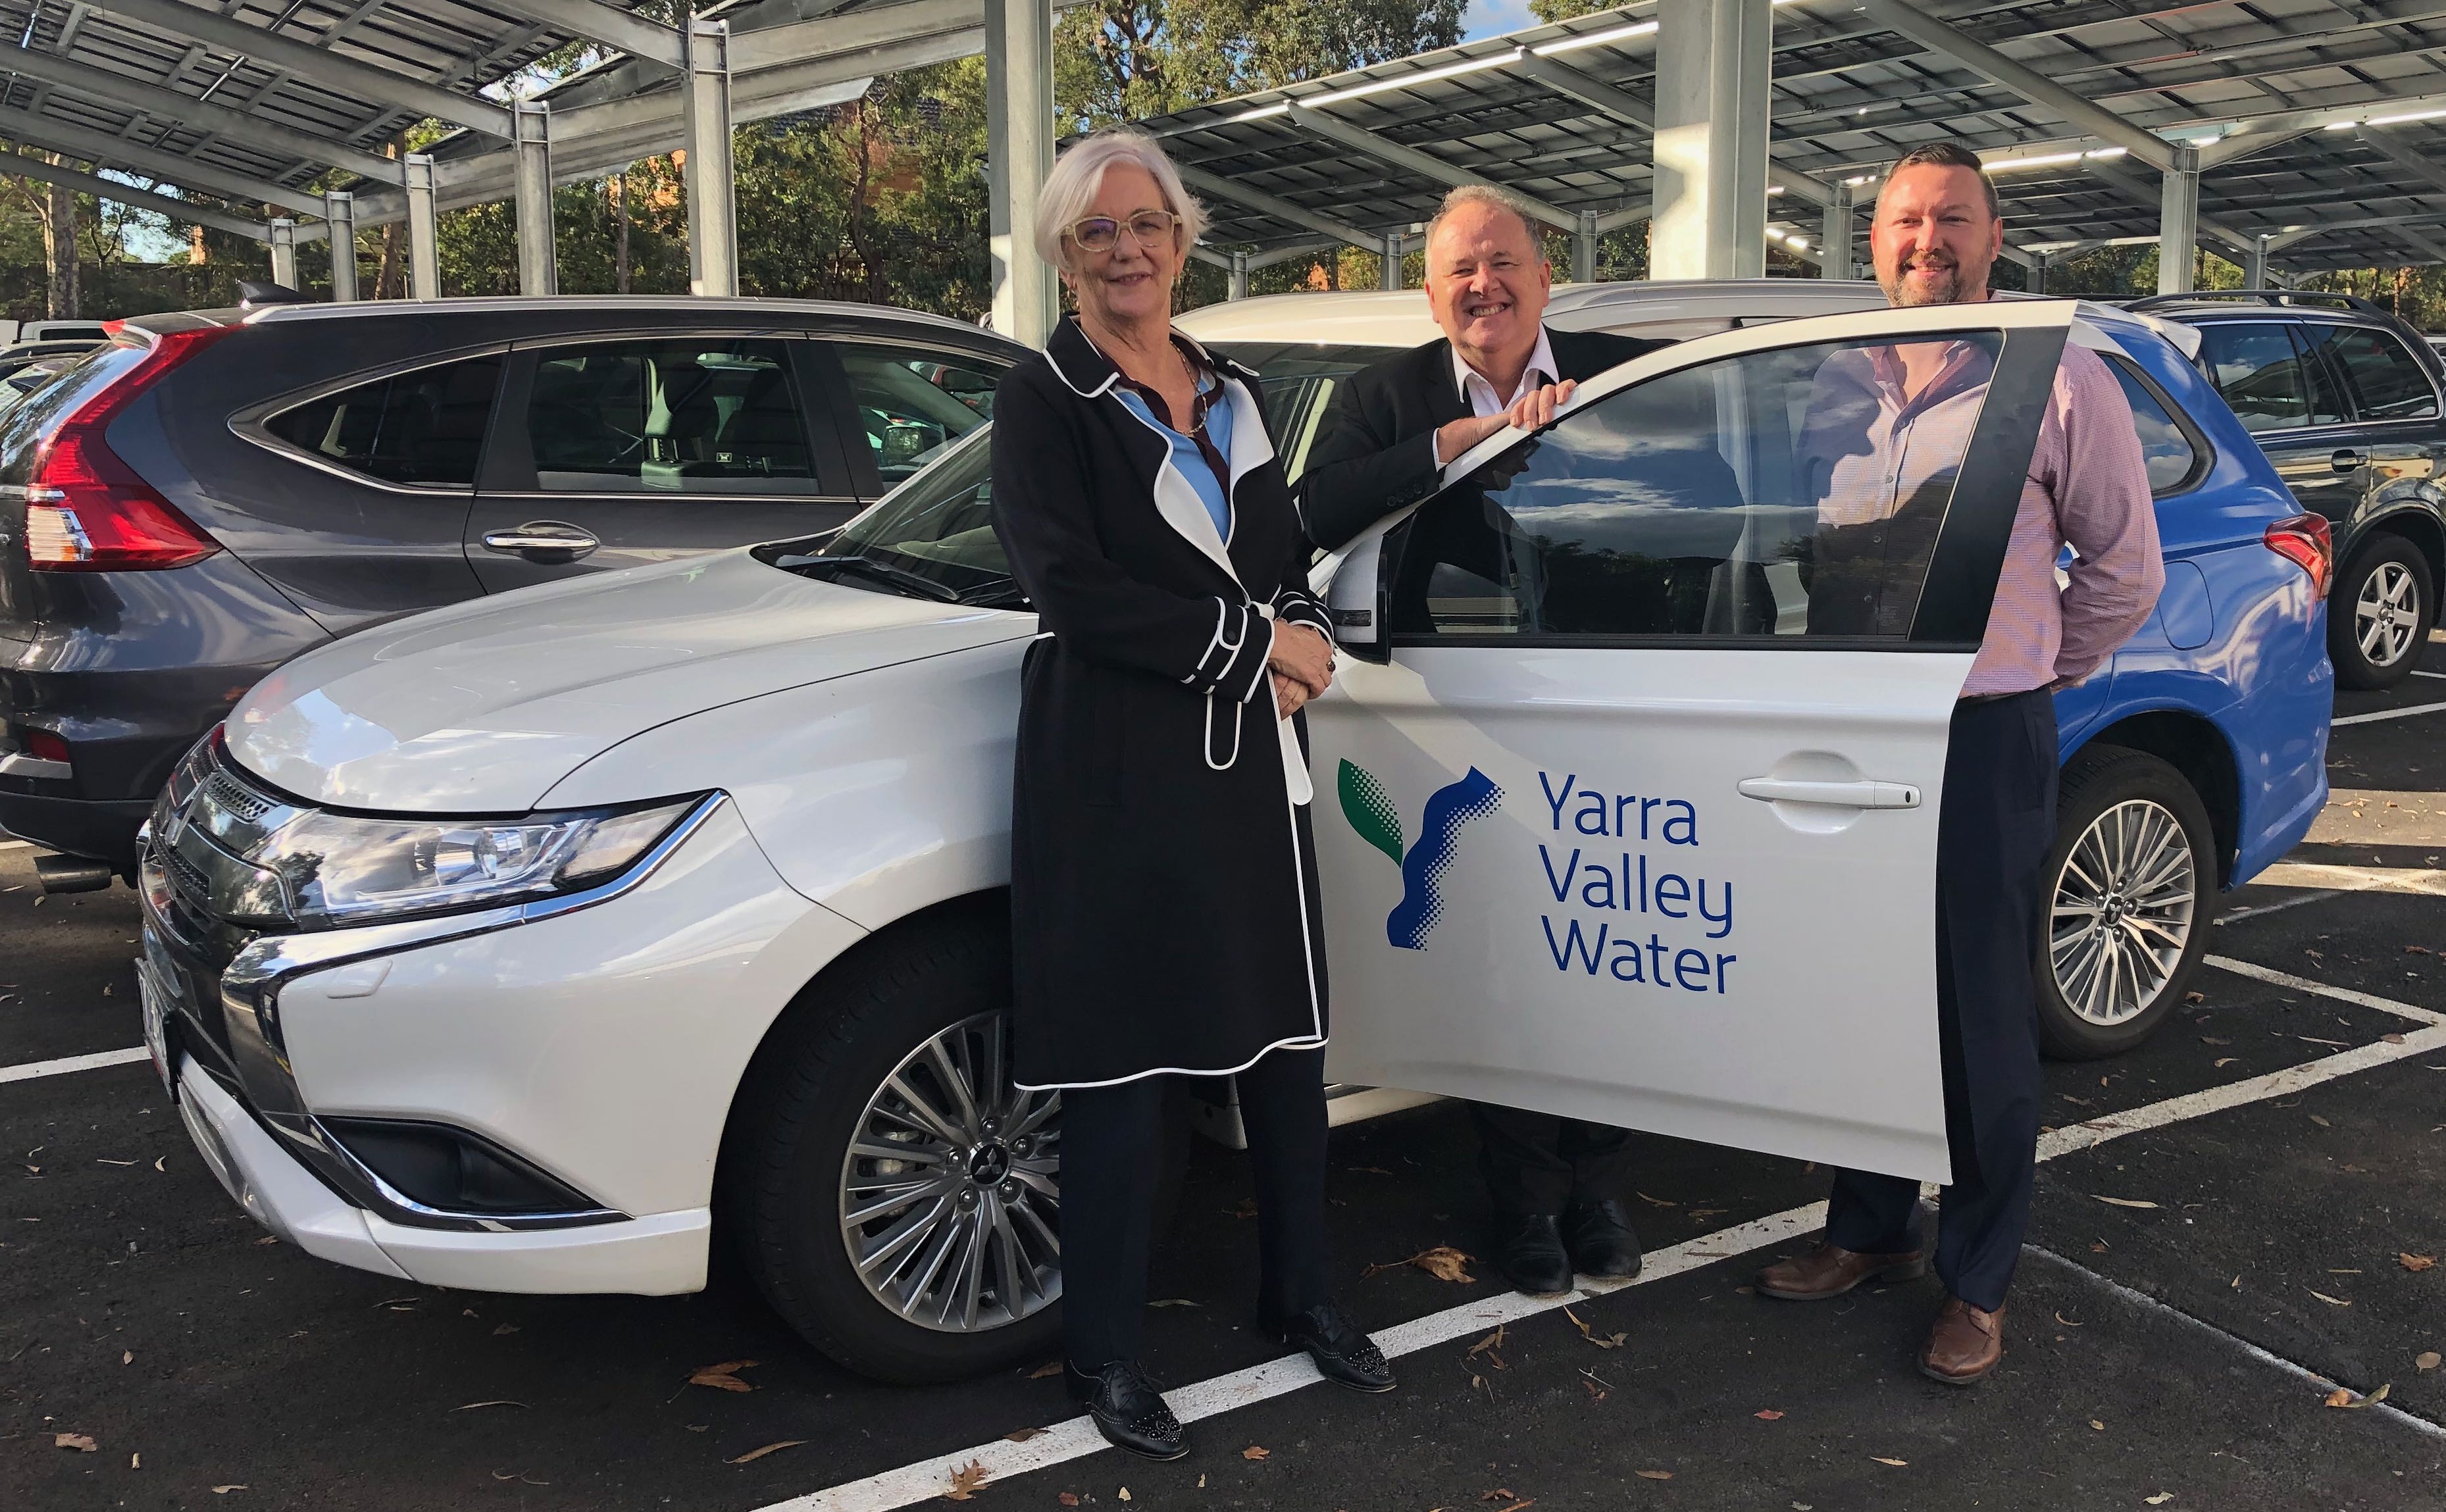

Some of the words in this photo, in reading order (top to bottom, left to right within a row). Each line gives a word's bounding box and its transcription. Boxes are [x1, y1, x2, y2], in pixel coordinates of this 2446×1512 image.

[1539, 771, 1699, 845] Yarra
[1539, 845, 1733, 938] Valley
[1541, 915, 1737, 994] Water
